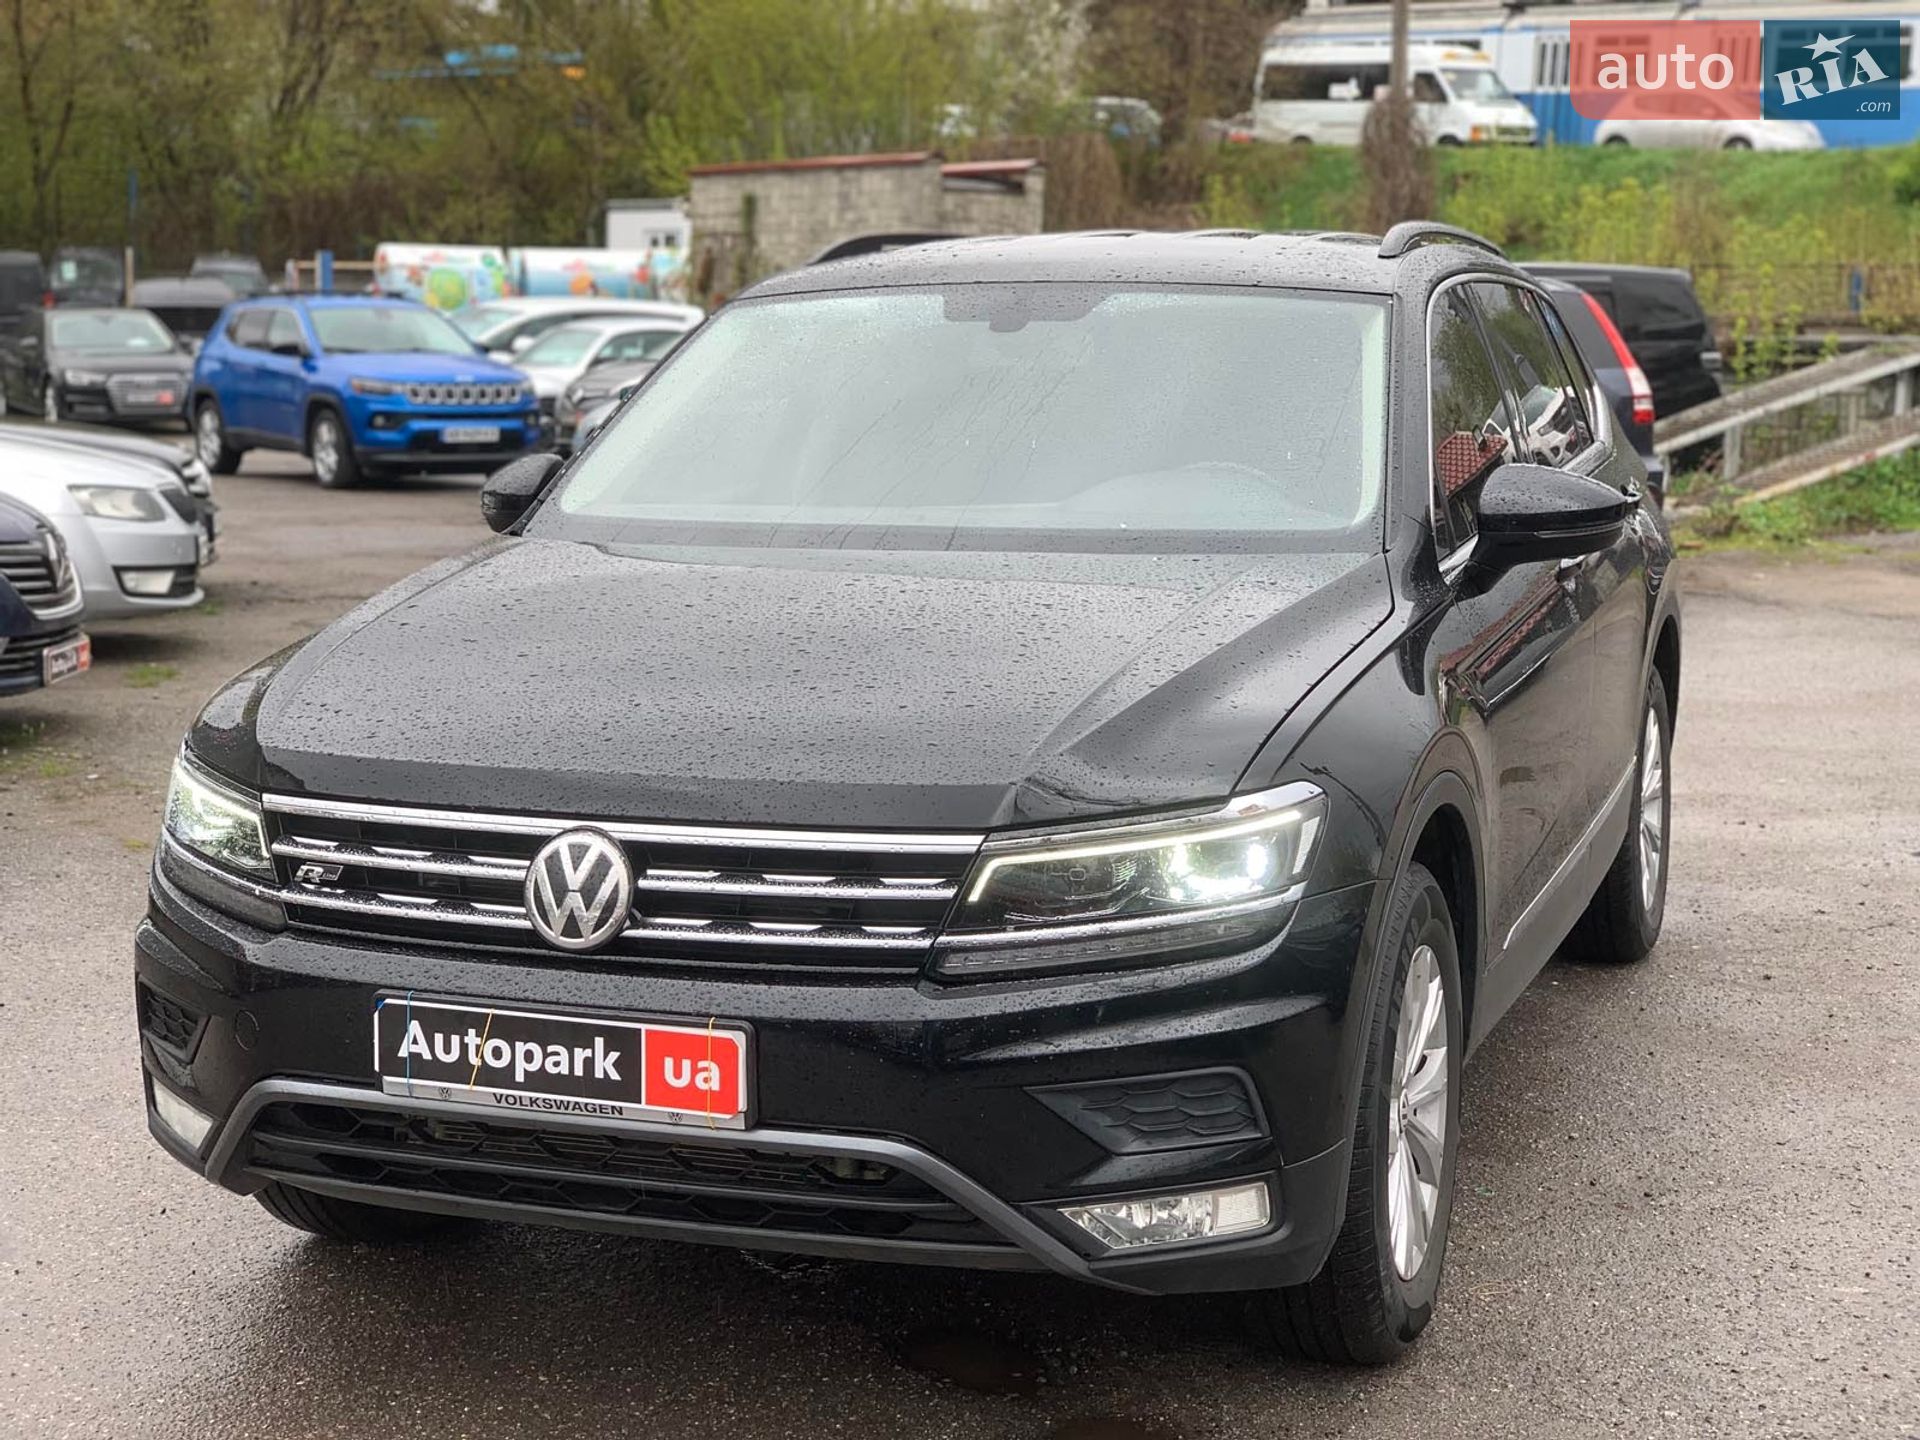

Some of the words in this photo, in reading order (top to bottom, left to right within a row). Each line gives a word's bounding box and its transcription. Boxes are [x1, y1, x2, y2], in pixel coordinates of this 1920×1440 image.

[294, 865, 324, 883] R
[397, 1019, 623, 1083] Autopark
[664, 1056, 721, 1092] ua
[492, 1092, 624, 1117] VOLKSWAGEN
